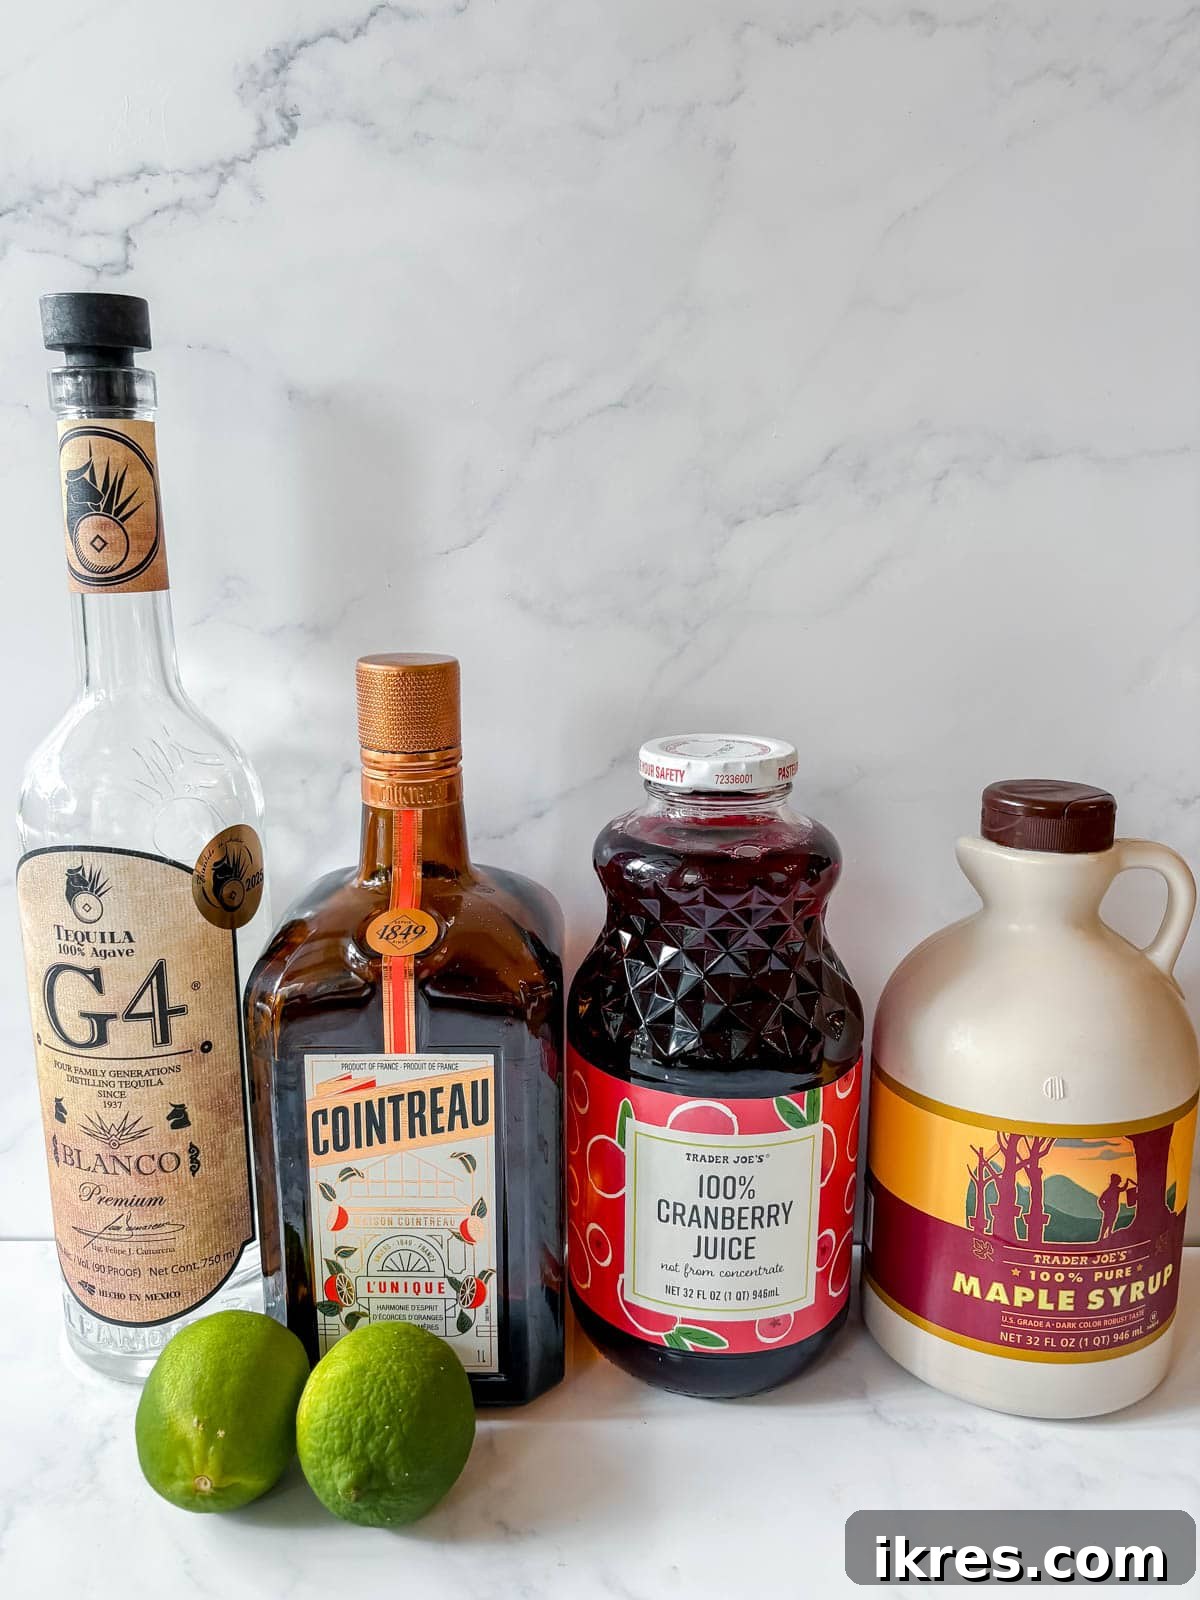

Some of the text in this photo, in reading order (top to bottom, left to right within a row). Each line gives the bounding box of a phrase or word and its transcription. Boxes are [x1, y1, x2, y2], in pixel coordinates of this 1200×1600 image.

[655, 765, 686, 783] SAFETY
[715, 774, 753, 785] 72336001
[53, 924, 136, 947] TEQUILA
[377, 924, 426, 941] 1849
[58, 943, 135, 960] 100% Agave
[43, 957, 189, 1050] G4
[54, 1060, 181, 1078] FOUR FAMILY GENERATIONS
[341, 1063, 367, 1071] PRODUCT
[376, 1063, 399, 1071] FRANCE
[403, 1063, 427, 1071] PRODUIT
[436, 1063, 459, 1071] FRANCE
[66, 1074, 164, 1090] DISTILLING TEQUILA
[97, 1090, 127, 1099] SINCE
[103, 1101, 122, 1109] 1937
[311, 1078, 490, 1156] COINTREAU
[62, 1142, 182, 1177] BLANCO
[685, 1152, 729, 1164] TRADER
[78, 1181, 168, 1208] Premium
[698, 1174, 756, 1200] 100%
[397, 1216, 455, 1227] COINTREAU
[657, 1198, 794, 1231] CRANBERRY
[693, 1235, 757, 1261] JUICE
[107, 1265, 141, 1278] PROOF)
[149, 1267, 168, 1276] Net
[171, 1262, 200, 1274] Cont.
[201, 1254, 221, 1268] 750
[1033, 1254, 1088, 1265] TRADER
[660, 1262, 784, 1278] not from concentrate
[1029, 1266, 1133, 1283] 100% PURE
[99, 1289, 181, 1301] HECHO EN MEXICO
[366, 1281, 446, 1296] L'UNIQUE
[665, 1284, 780, 1301] NET 32 FL OZ (1 QT) 946mL
[951, 1263, 1174, 1312] MAPLE SYRUP
[409, 1313, 444, 1321] D'ORANGES
[1001, 1315, 1015, 1324] U.S.
[1017, 1318, 1043, 1328] GRADE
[1055, 1321, 1077, 1329] DARK
[1079, 1320, 1102, 1329] COLOR
[1103, 1316, 1127, 1327] ROBUST
[1128, 1310, 1145, 1322] TASTE
[1000, 1331, 1023, 1343] NET
[1026, 1335, 1040, 1345] 32
[1044, 1337, 1056, 1347] FL
[1060, 1337, 1075, 1348] OZ
[1079, 1337, 1089, 1348] (1
[1092, 1335, 1110, 1347] QT)
[1113, 1330, 1130, 1343] 946
[1131, 1325, 1144, 1338] mL
